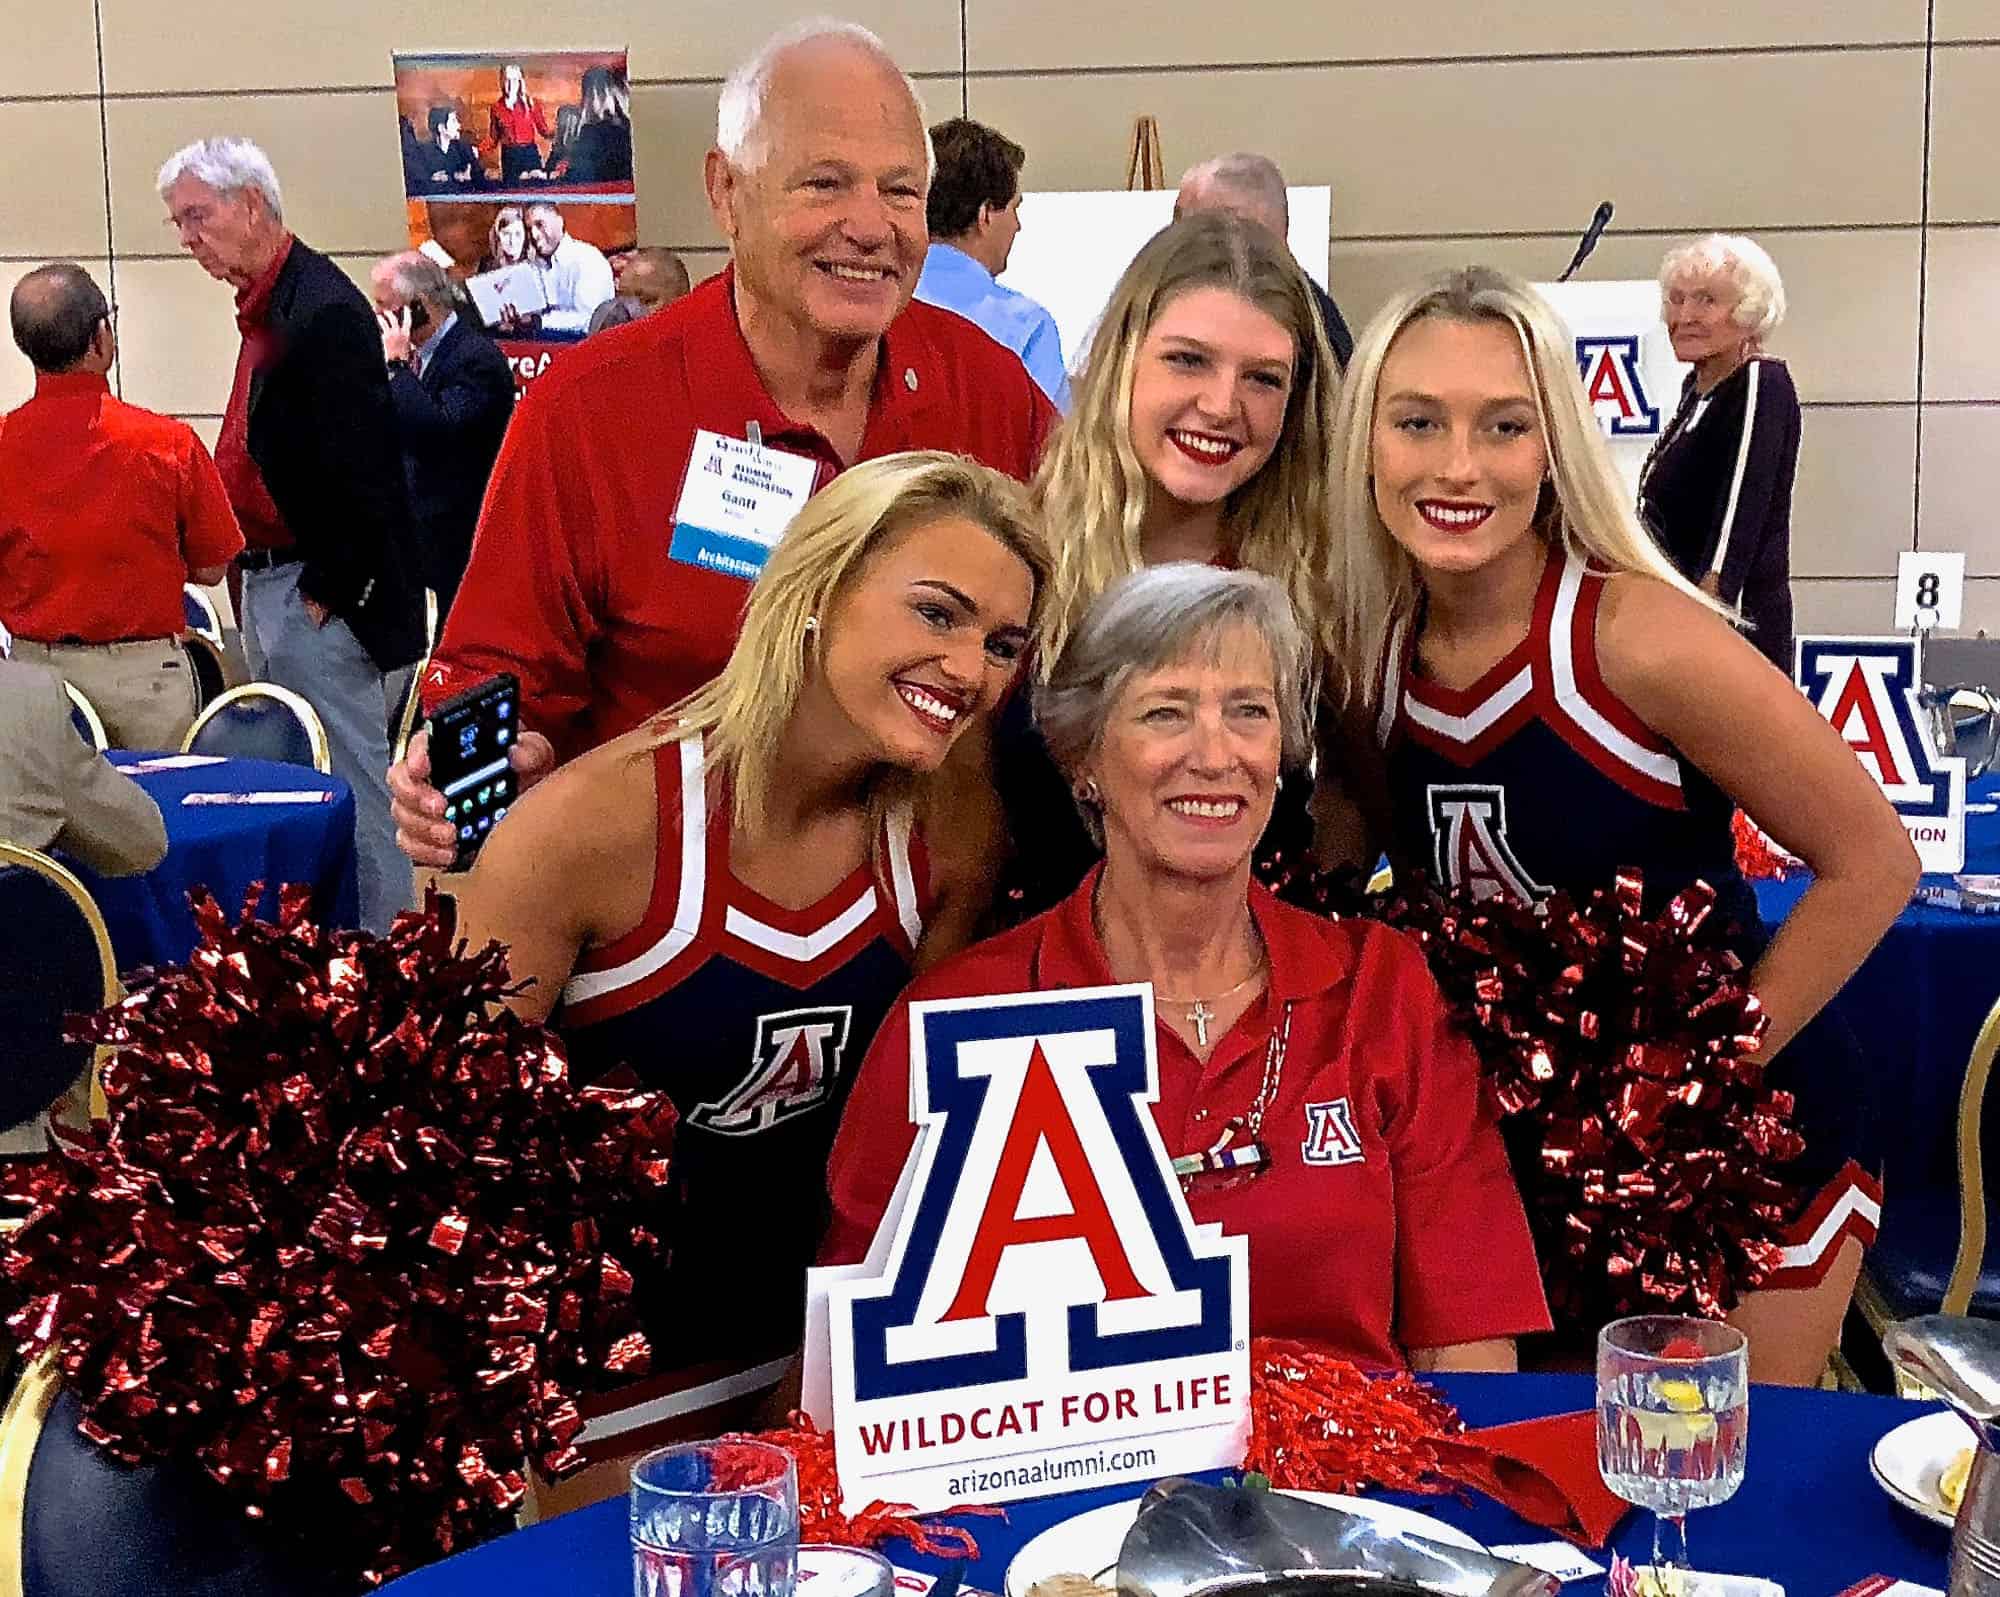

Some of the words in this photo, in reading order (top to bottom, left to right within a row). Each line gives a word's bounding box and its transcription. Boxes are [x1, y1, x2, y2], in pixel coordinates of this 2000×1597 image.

[1915, 572, 1940, 608] 8
[1301, 1096, 1366, 1166] A
[852, 994, 1233, 1403] A
[858, 1400, 1045, 1456] WILDCAT
[1061, 1387, 1139, 1428] FOR
[1154, 1374, 1232, 1415] LIFE
[947, 1447, 1157, 1496] arizonaalumni.com
